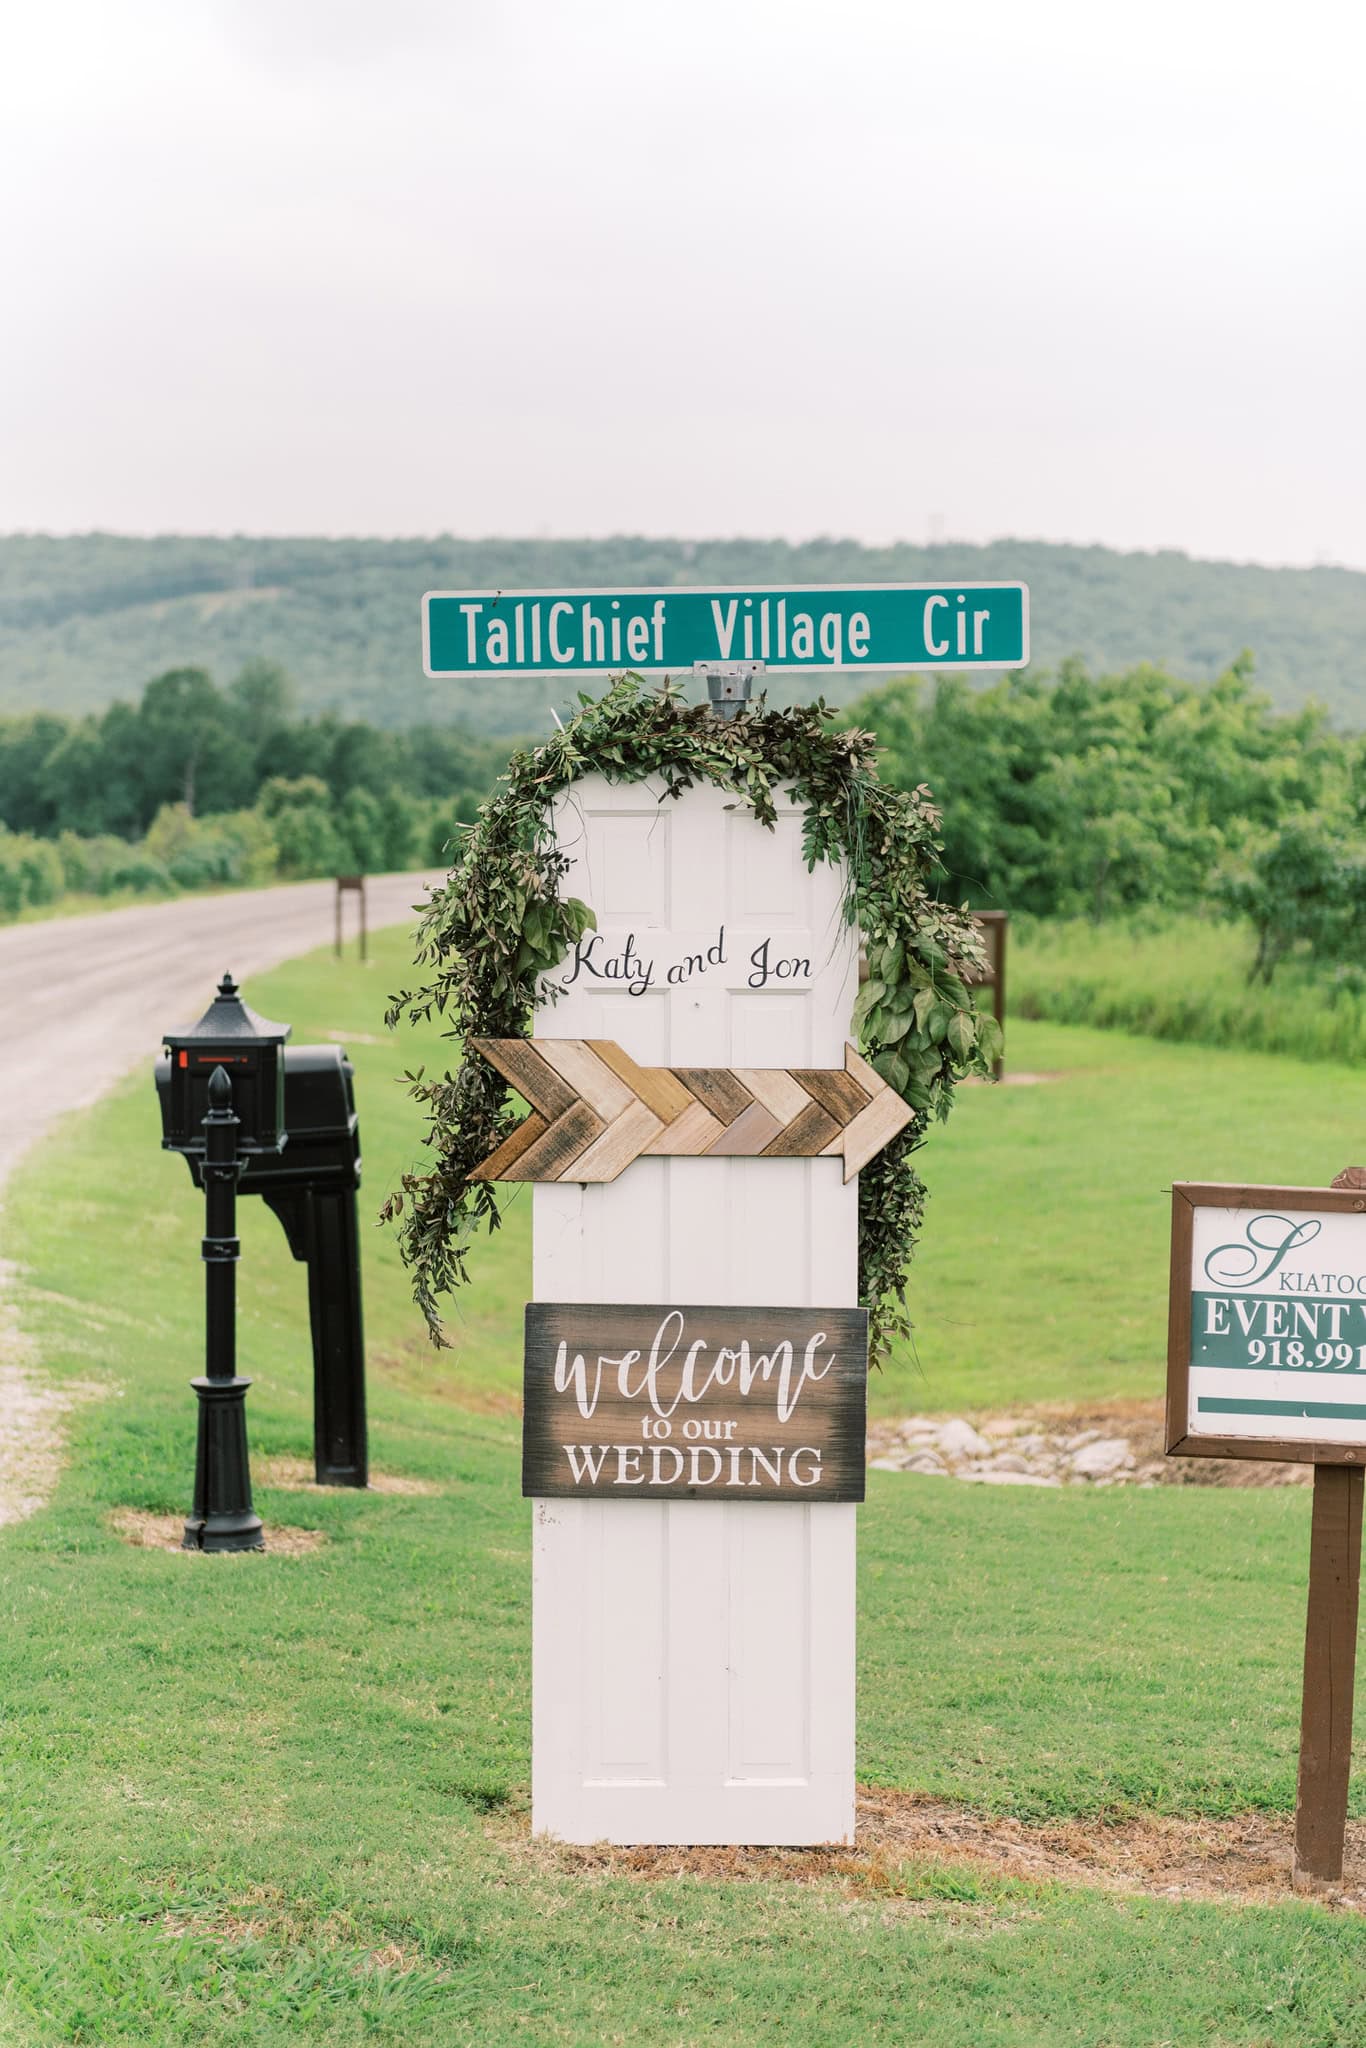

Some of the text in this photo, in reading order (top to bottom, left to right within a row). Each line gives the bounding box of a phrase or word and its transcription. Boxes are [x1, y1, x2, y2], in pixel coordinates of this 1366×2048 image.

[459, 594, 990, 665] TallChief Village Cir
[562, 925, 812, 996] Katy and Jon
[1204, 1298, 1350, 1341] EVENT
[554, 1311, 836, 1423] welcome
[641, 1416, 738, 1440] to our
[563, 1445, 824, 1487] WEDDING
